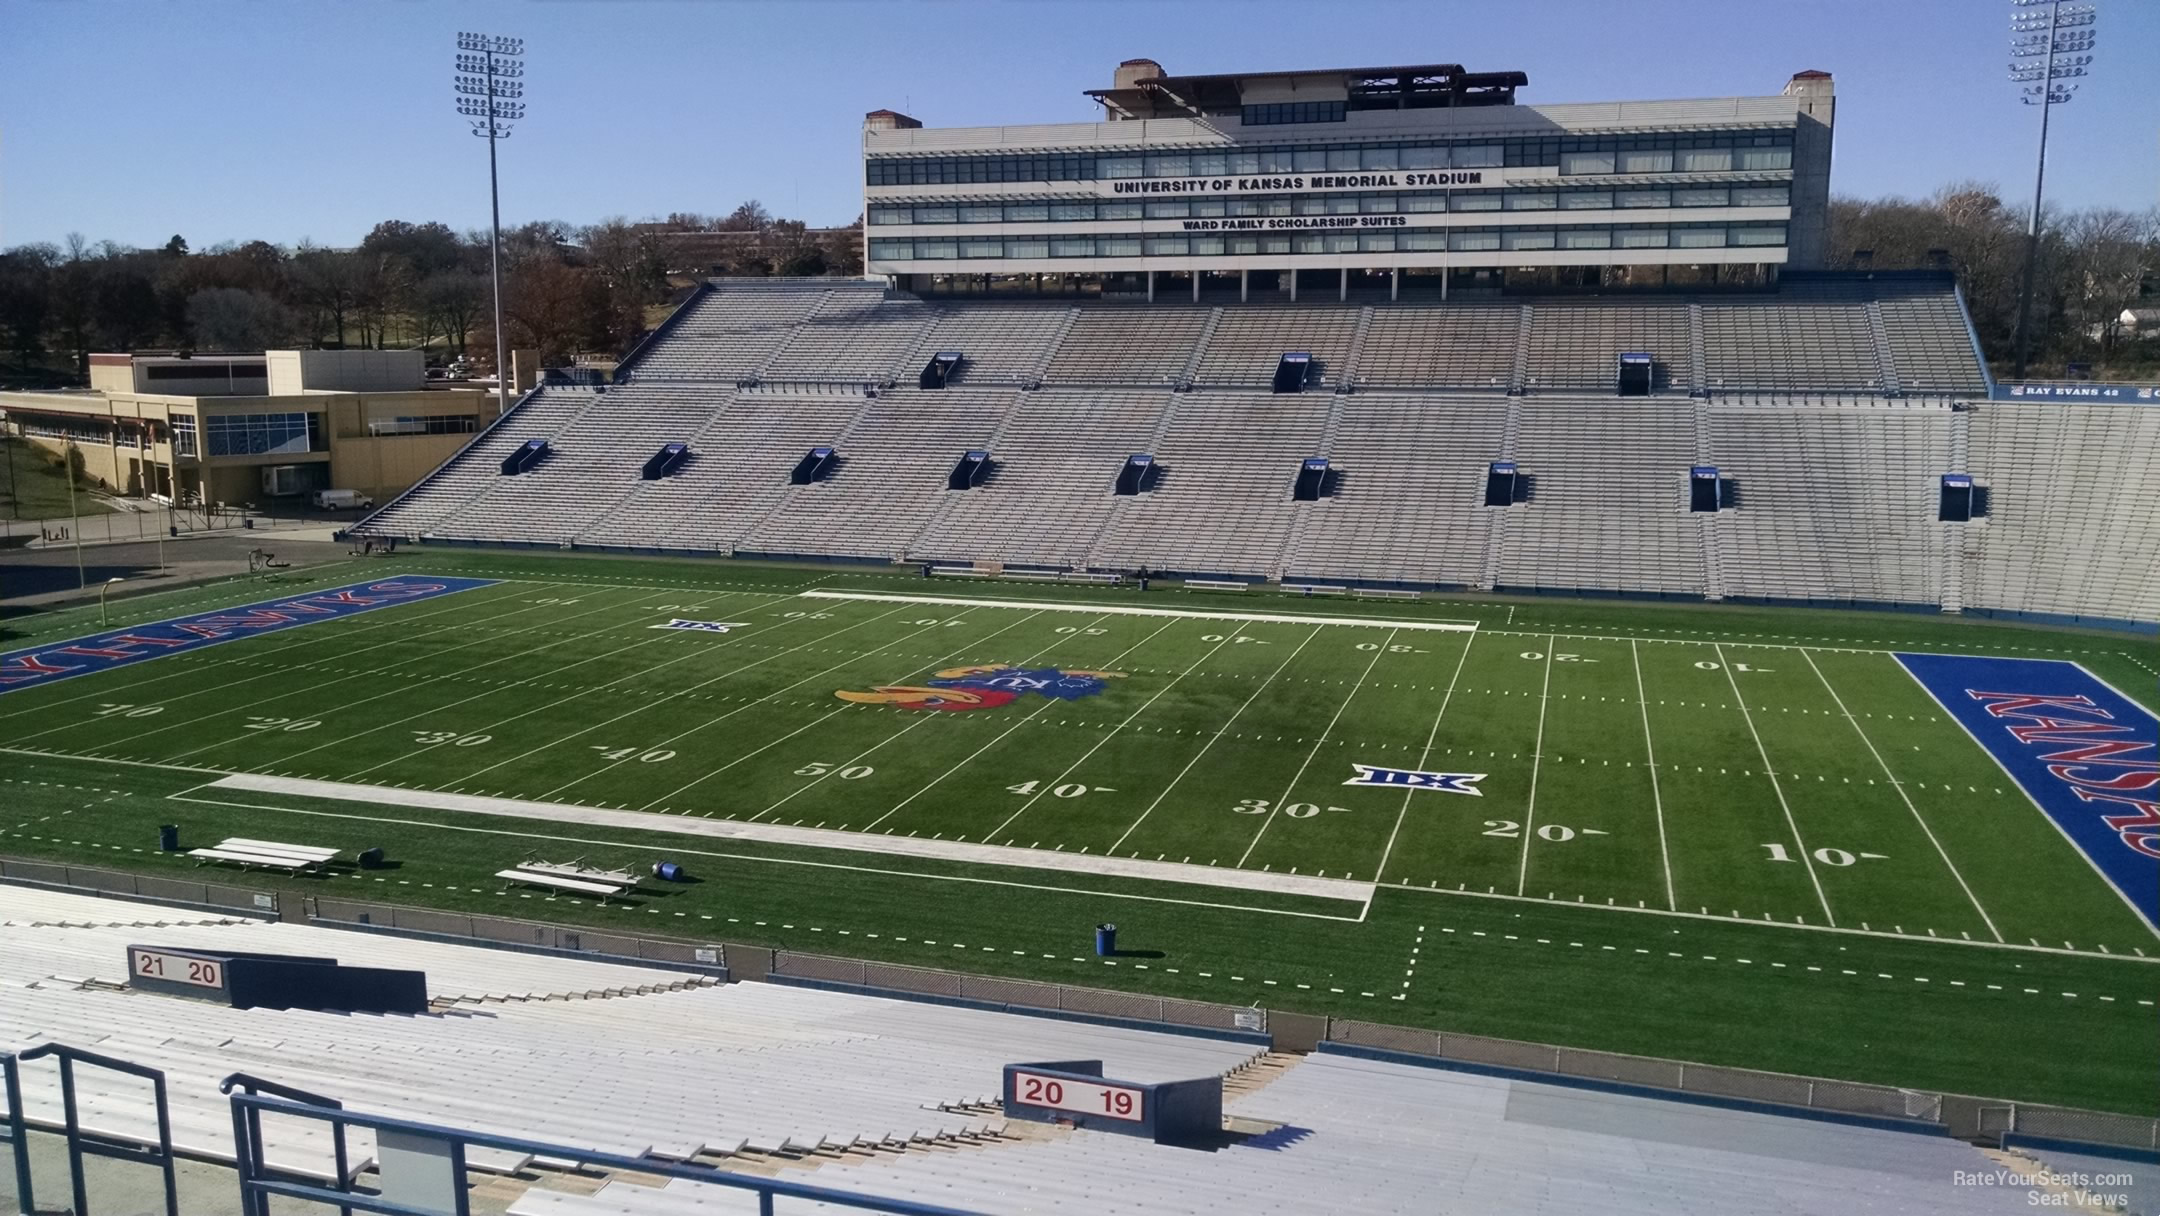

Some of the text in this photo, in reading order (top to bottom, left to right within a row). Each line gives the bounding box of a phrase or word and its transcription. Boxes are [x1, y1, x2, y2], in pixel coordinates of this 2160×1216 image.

[1114, 172, 1482, 193] UNIVERSITY OF KANSAS MEMORIAL STADIUM
[1182, 216, 1406, 231] WARD FAMILY SCHOLARSHIP SUITES
[2026, 387, 2051, 395] RAY
[2055, 388, 2098, 396] EVANS
[0, 582, 447, 684] YHAWKS
[242, 718, 322, 731] 20
[415, 732, 492, 746] 30
[600, 747, 676, 762] 40
[793, 762, 874, 779] 50
[1005, 780, 1087, 798] 40
[1232, 799, 1320, 818] 30
[1481, 820, 1575, 842] 20
[1760, 843, 1856, 867] 10
[141, 954, 216, 984] 21 20
[1025, 1078, 1133, 1115] 20 19
